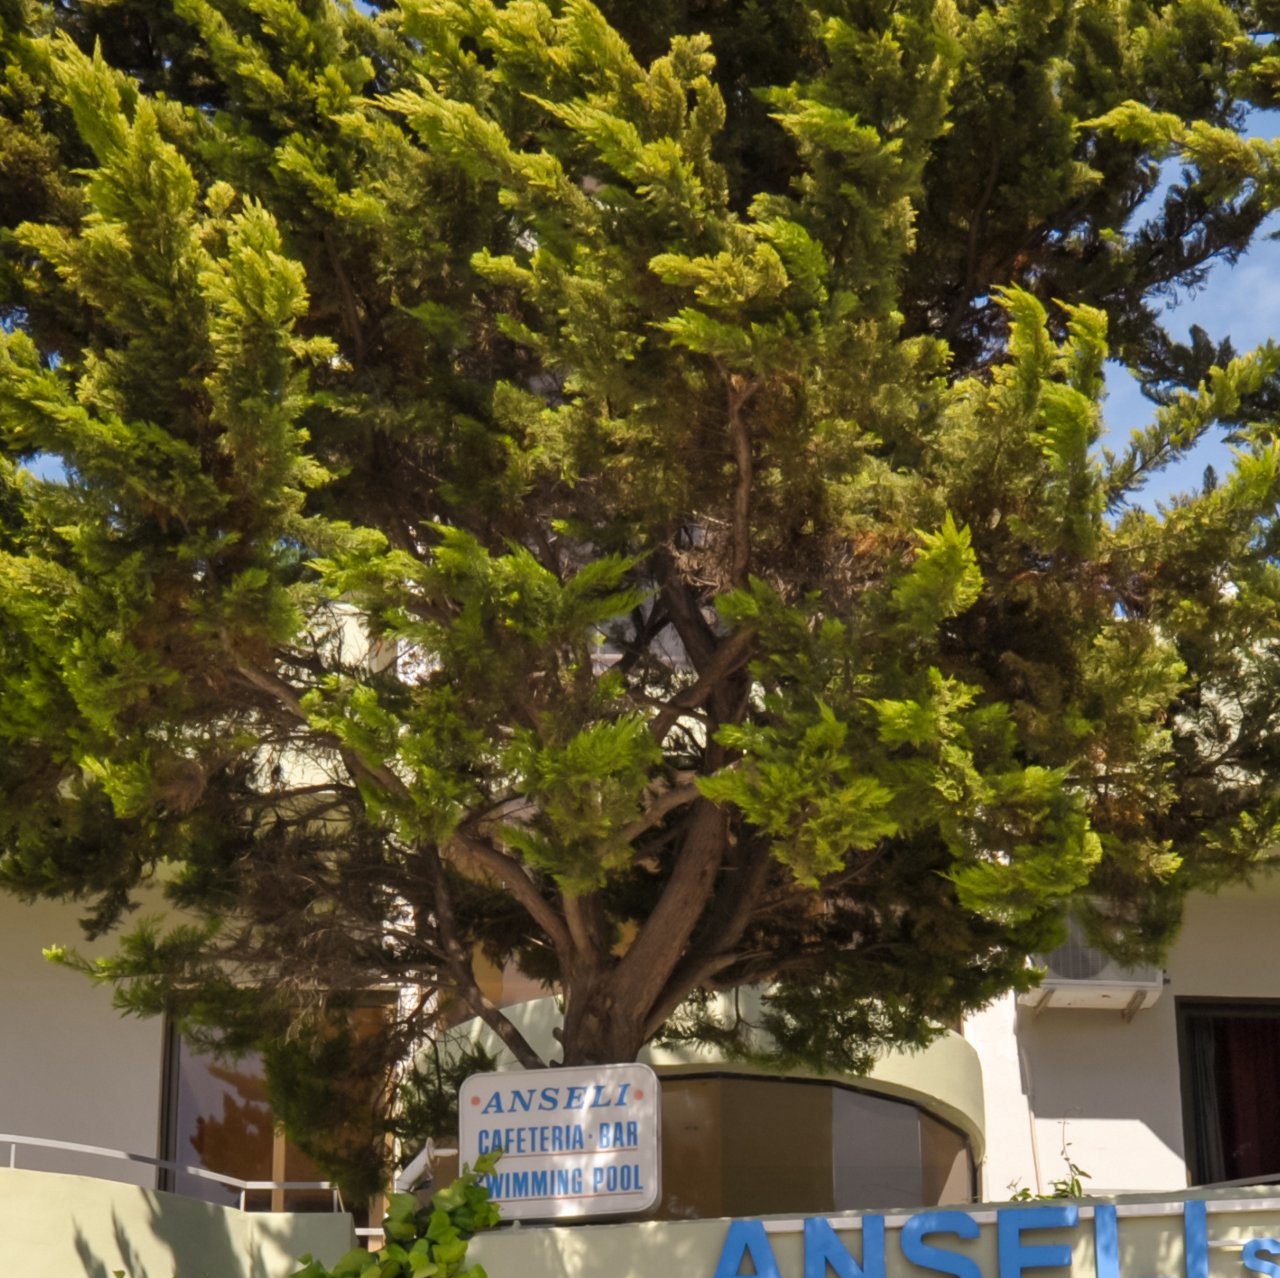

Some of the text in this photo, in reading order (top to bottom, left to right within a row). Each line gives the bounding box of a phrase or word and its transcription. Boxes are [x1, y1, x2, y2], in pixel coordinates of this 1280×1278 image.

[481, 1083, 631, 1115] ANSELI
[478, 1121, 639, 1156] CAFETERIA BAR
[473, 1164, 644, 1200] WIMMING POOL
